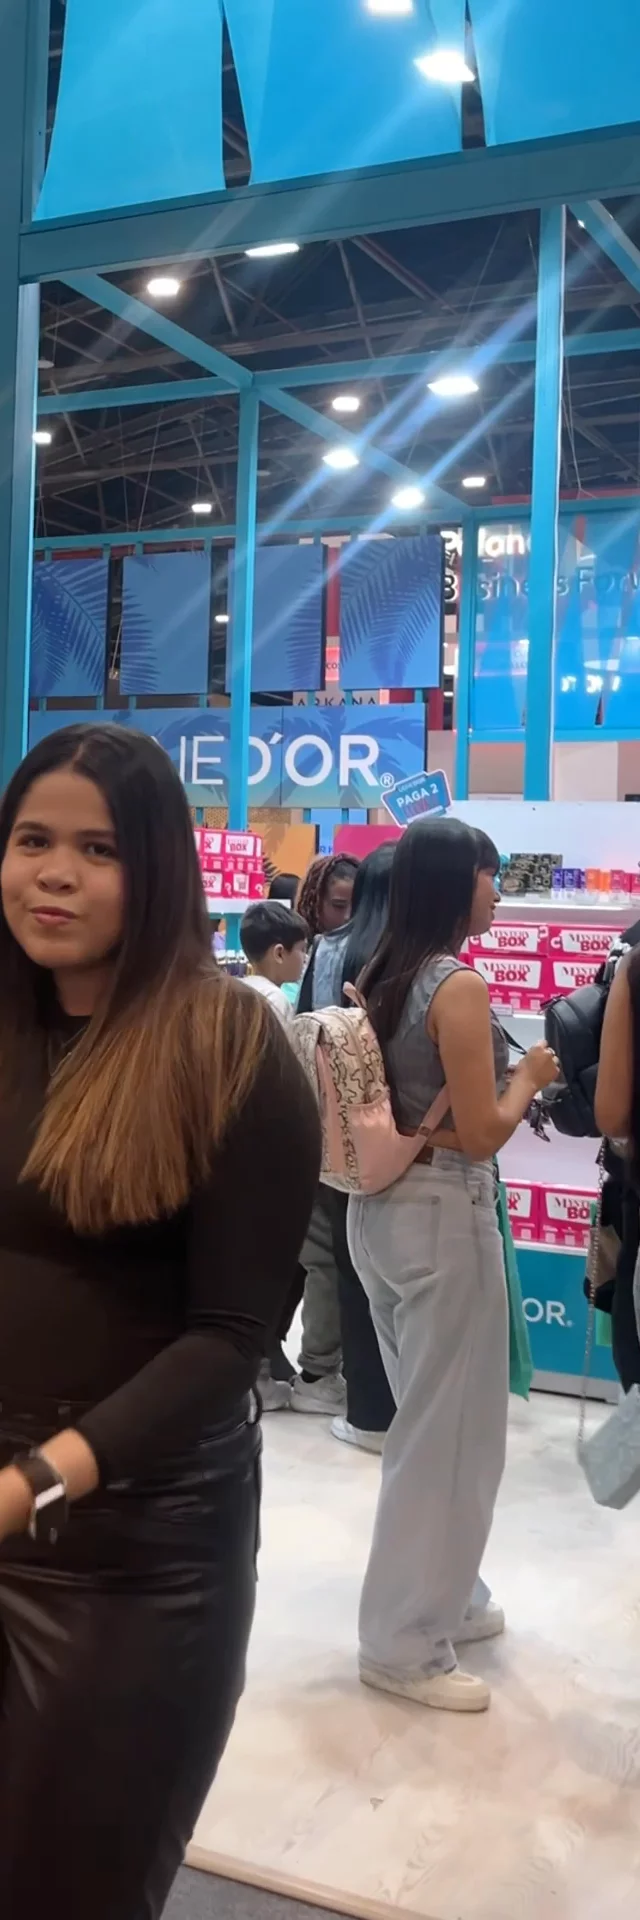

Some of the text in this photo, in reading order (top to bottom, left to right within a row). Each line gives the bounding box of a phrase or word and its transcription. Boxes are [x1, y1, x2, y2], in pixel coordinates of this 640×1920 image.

[396, 787, 430, 808] PAGA
[429, 783, 439, 794] 2
[497, 936, 527, 947] BOX
[580, 940, 611, 951] BOX
[482, 962, 531, 973] MYSTERY
[494, 970, 528, 982] BOX
